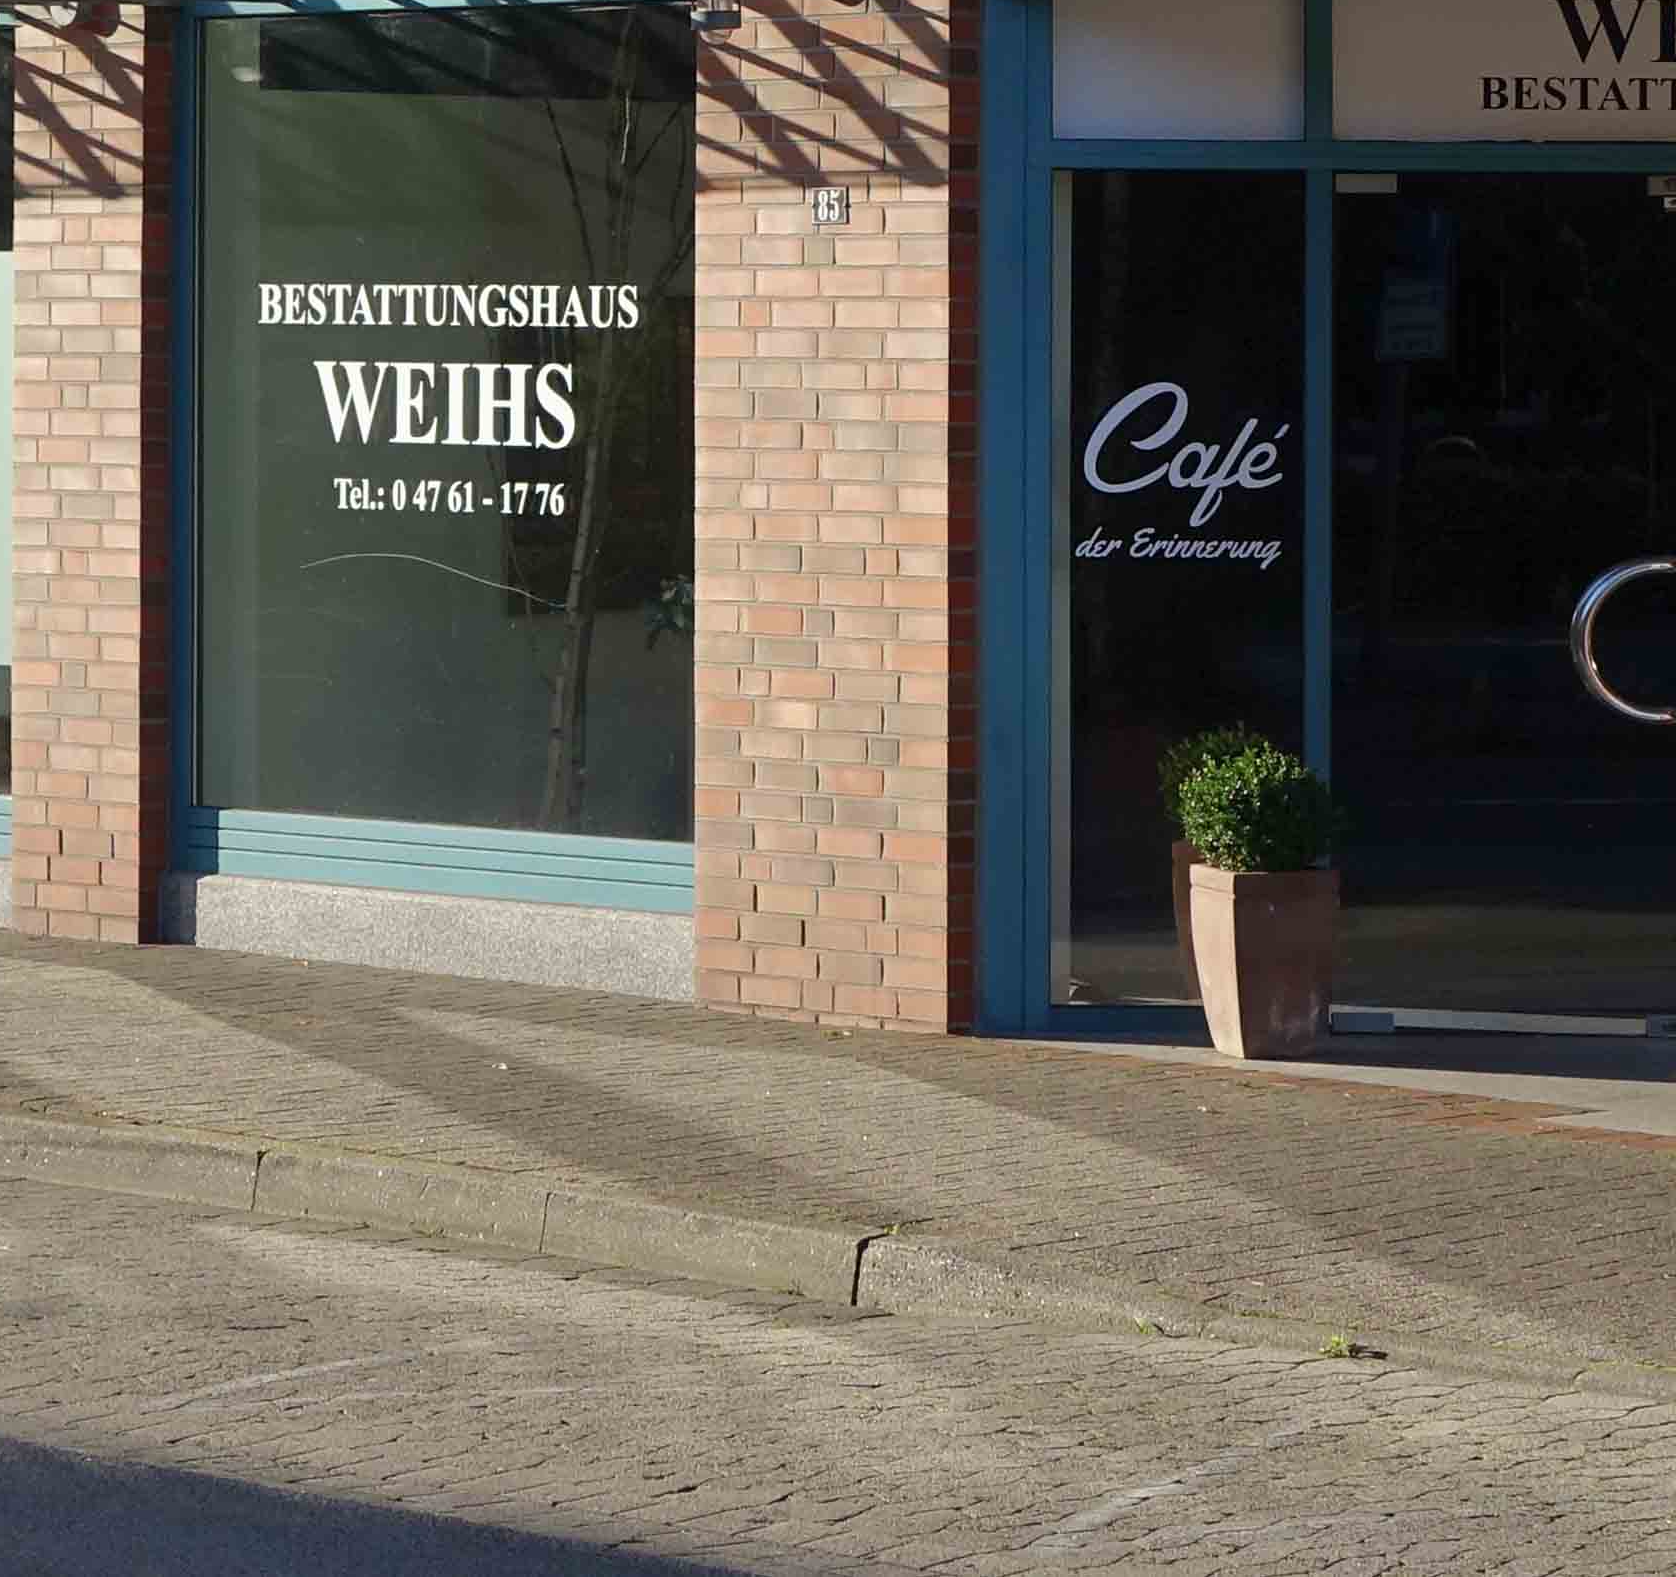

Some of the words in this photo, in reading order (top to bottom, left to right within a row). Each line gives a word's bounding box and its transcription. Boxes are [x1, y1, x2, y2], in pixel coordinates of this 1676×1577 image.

[817, 189, 840, 222] 85
[257, 283, 640, 329] BESTATTUNGSHAUS
[313, 360, 576, 450] WEIHS
[1083, 381, 1290, 527] Café
[333, 477, 385, 511] Tel.:
[391, 480, 407, 512] 0
[412, 480, 442, 513] 47
[447, 481, 475, 514] 61
[500, 482, 530, 515] 17
[535, 483, 566, 517] 76
[1075, 526, 1123, 558] der
[1129, 527, 1283, 570] Erinnerung
